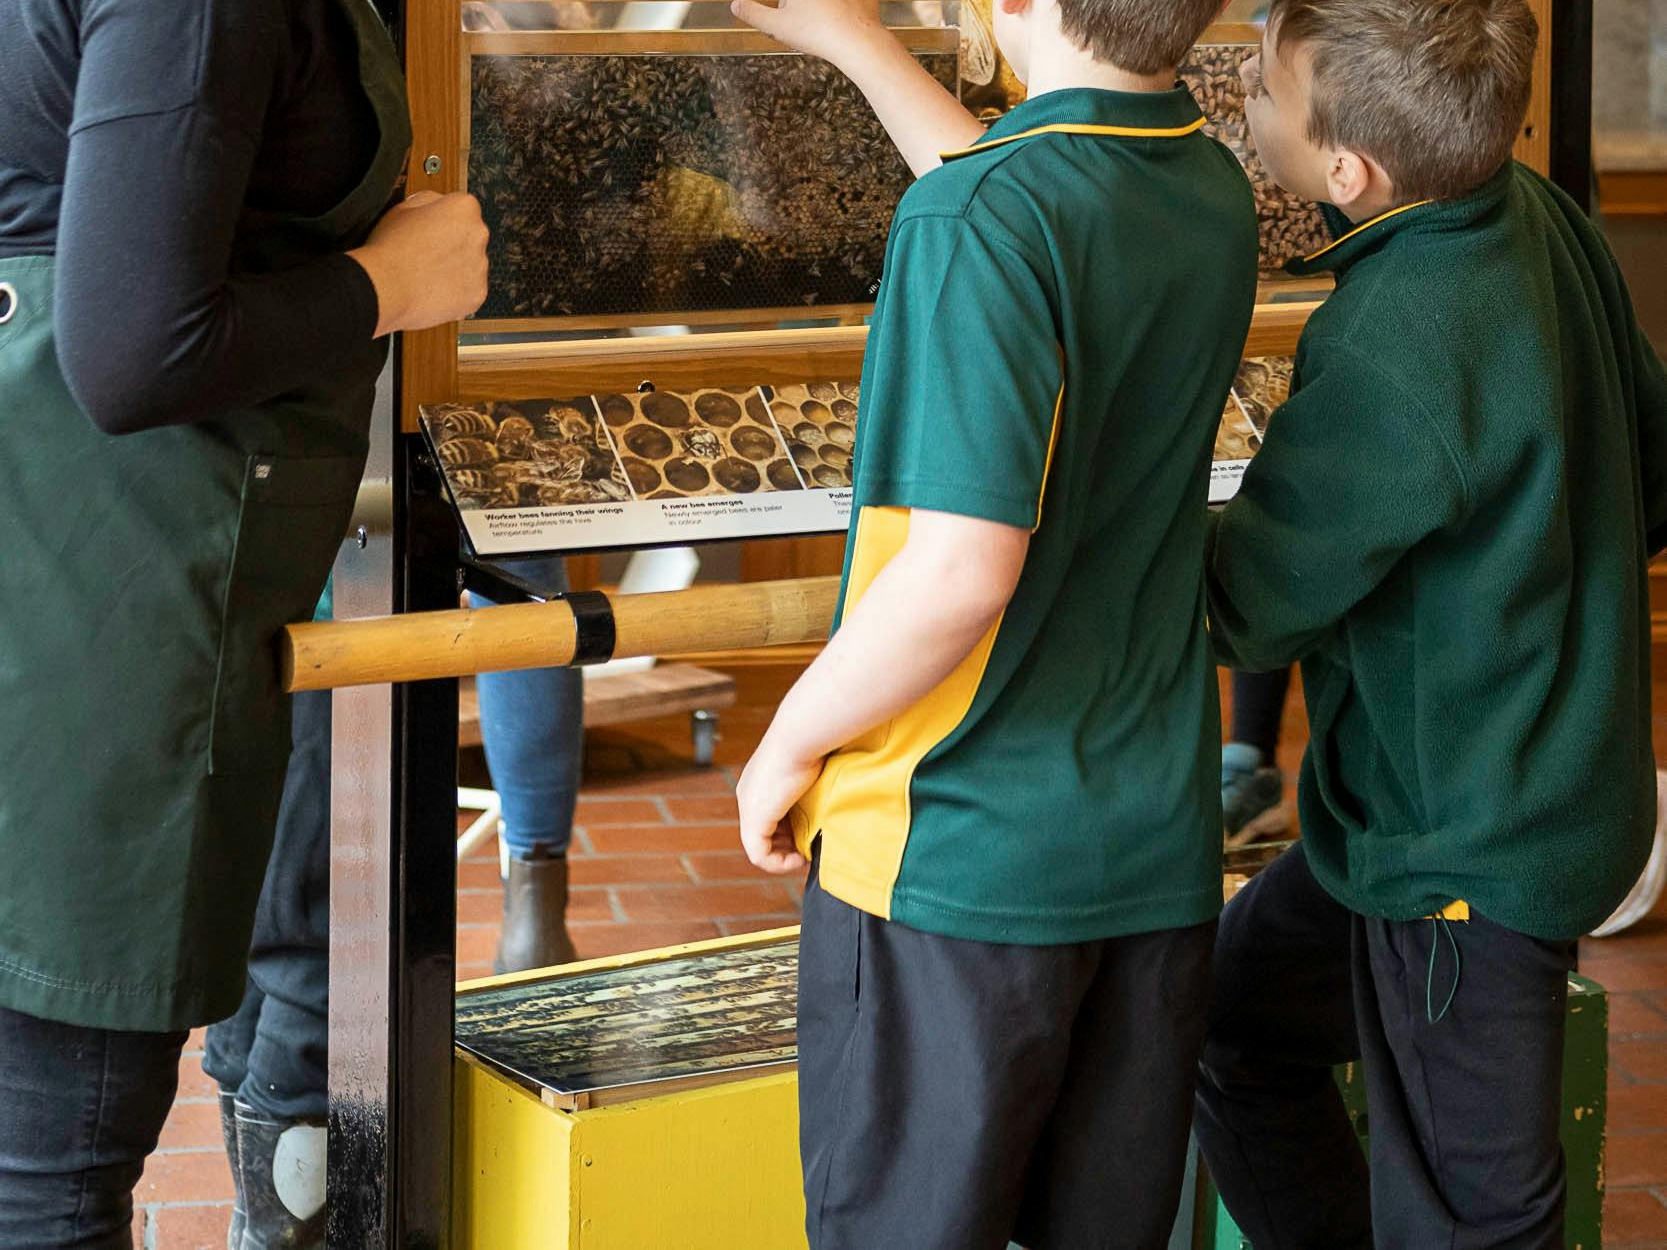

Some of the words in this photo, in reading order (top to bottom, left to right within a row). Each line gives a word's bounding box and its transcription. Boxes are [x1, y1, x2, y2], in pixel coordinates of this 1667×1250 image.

[689, 501, 706, 509] bee
[707, 499, 744, 507] emerges
[484, 512, 517, 521] Worker
[518, 511, 540, 519] bees
[540, 510, 575, 518] fanning
[575, 508, 596, 516] their
[597, 507, 624, 515] wings
[692, 508, 728, 516] emerged
[728, 507, 748, 515] bees
[519, 518, 558, 528] regulates
[491, 529, 544, 537] temperature
